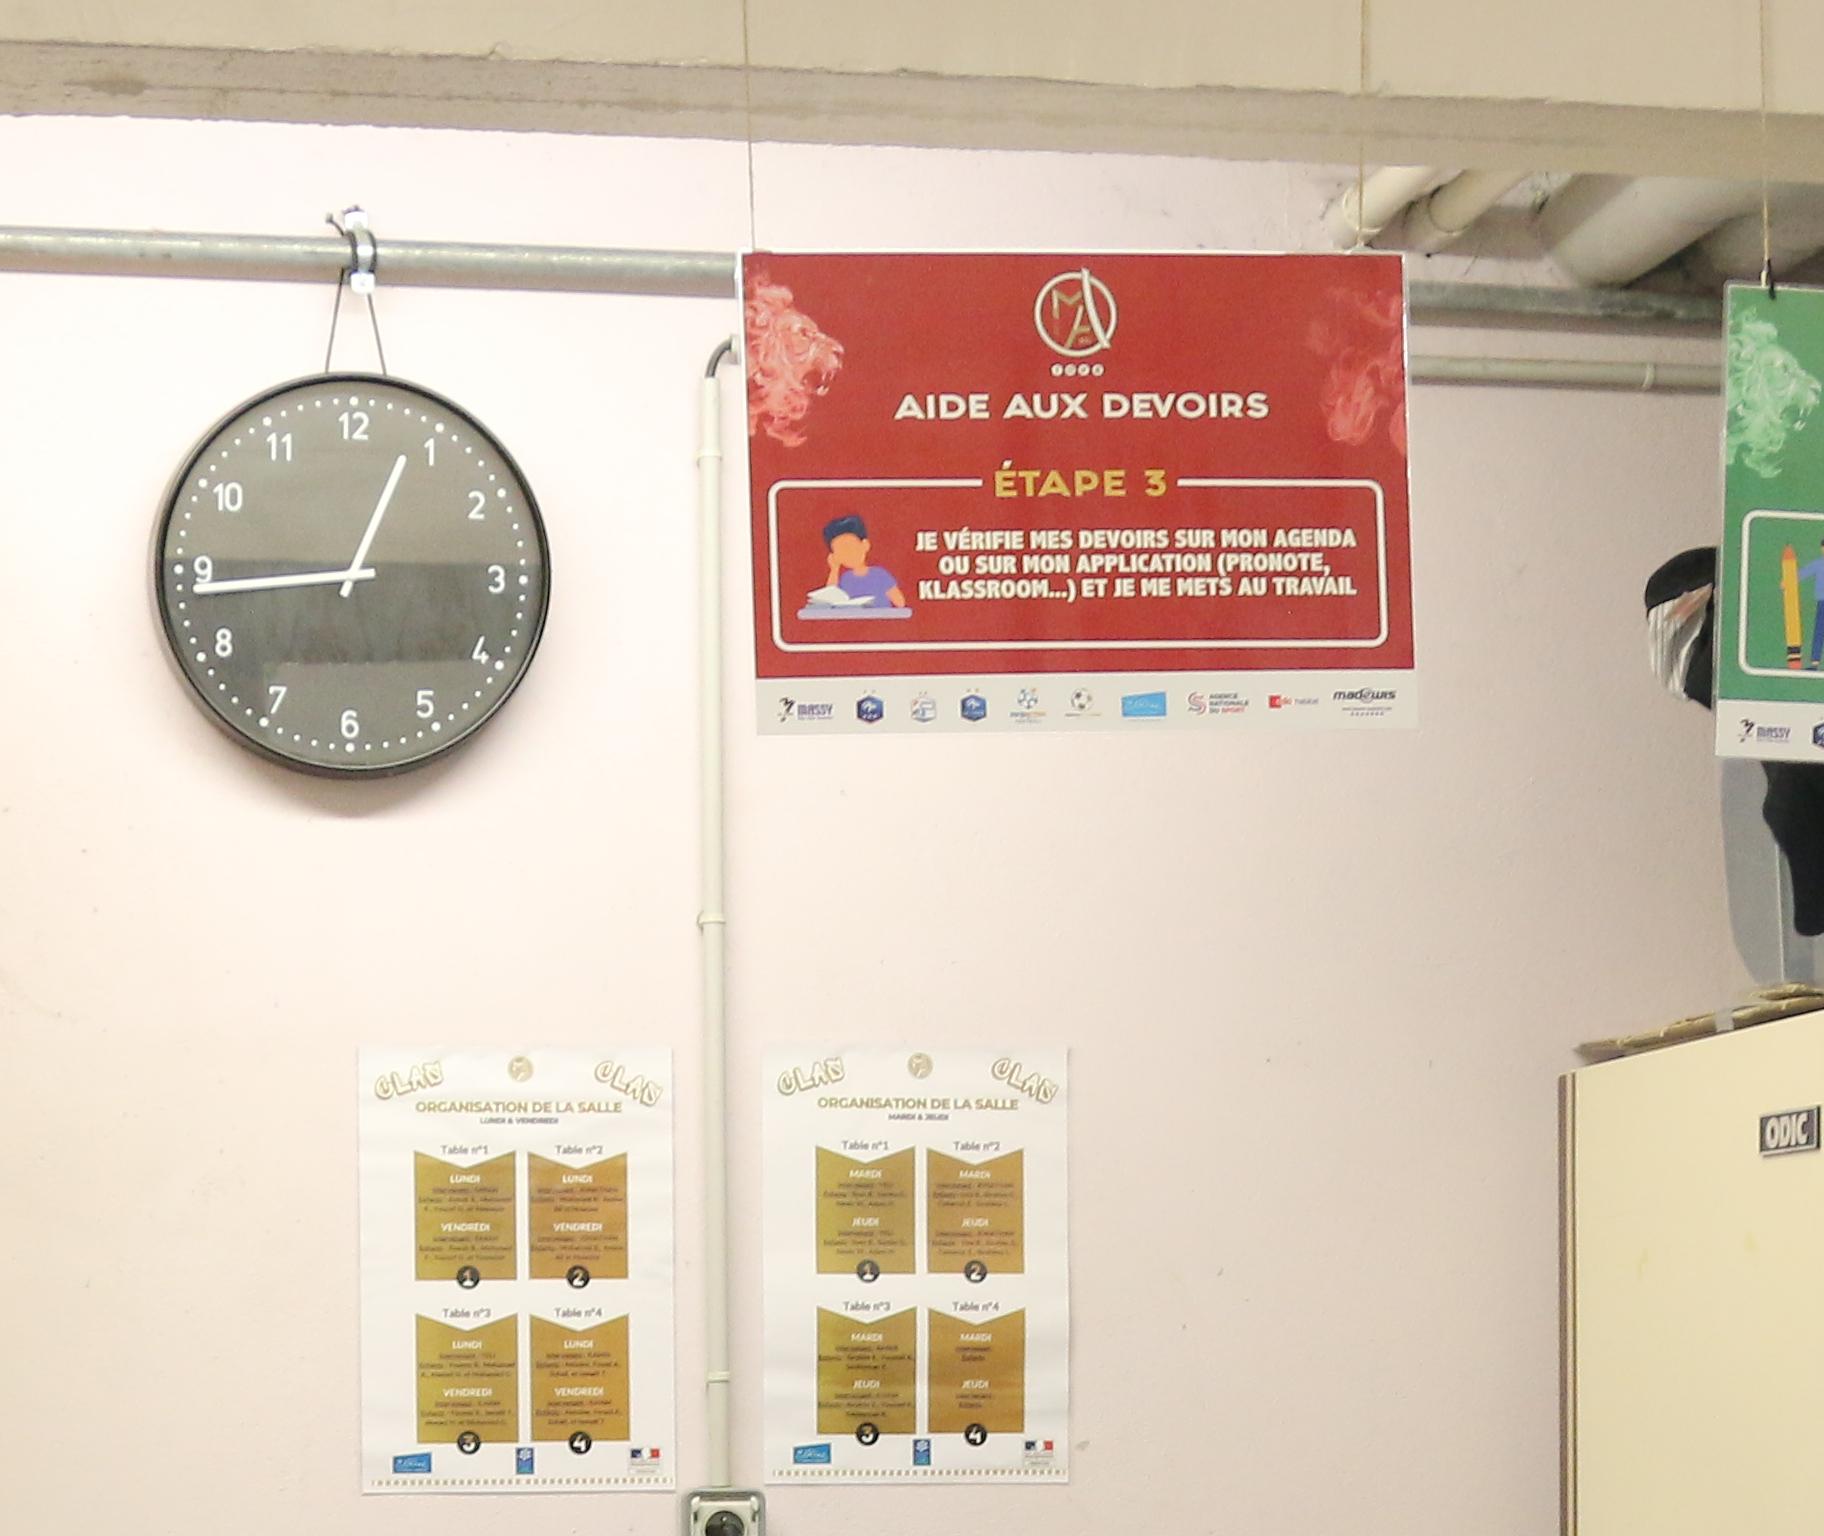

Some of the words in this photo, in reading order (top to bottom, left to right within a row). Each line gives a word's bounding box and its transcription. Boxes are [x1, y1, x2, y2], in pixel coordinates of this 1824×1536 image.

[895, 394, 989, 419] AIDE
[1004, 394, 1087, 418] AUX
[1103, 393, 1268, 418] DEVOIRS
[339, 412, 369, 440] 12
[267, 433, 291, 461] 11
[424, 438, 434, 466] 1
[995, 460, 1126, 497] ÉTAPE
[1145, 470, 1166, 496] 3
[213, 482, 242, 511] 10
[468, 491, 485, 519] 2
[916, 532, 937, 550] JE
[944, 527, 1024, 550] VÉRIFIE
[1030, 531, 1073, 549] MES
[1079, 530, 1169, 548] DEVOIRS
[1175, 529, 1215, 548] SUR
[1221, 529, 1267, 547] MON
[1274, 529, 1356, 547] AGENDA
[193, 556, 213, 583] 9
[939, 556, 969, 574] OU
[976, 555, 1016, 574] SUR
[1023, 555, 1070, 573] MON
[1076, 553, 1211, 573] APPLICATION
[1217, 552, 1331, 577] (PRONOTE,
[488, 565, 505, 593] 3
[919, 579, 1076, 602] KLASSROOM...)
[1082, 579, 1108, 597] ET
[1114, 578, 1135, 597] JE
[1141, 578, 1171, 596] ME
[1177, 575, 1232, 596] METS
[1238, 577, 1266, 595] AU
[1272, 573, 1357, 595] TRAVAIL
[215, 629, 232, 657] 8
[473, 636, 489, 664] 4
[269, 686, 287, 714] 7
[417, 690, 434, 718] 5
[341, 710, 359, 738] 6
[416, 1101, 528, 1113] ORGANISATION
[532, 1101, 552, 1113] DE
[555, 1102, 574, 1113] LA
[578, 1102, 622, 1113] SALLE
[818, 1097, 927, 1109] ORGANISATION
[931, 1098, 950, 1109] DE
[954, 1099, 972, 1109] LA
[975, 1099, 1018, 1110] SALLE
[1765, 1111, 1809, 1149] ODIC
[442, 1145, 468, 1154] Table
[556, 1145, 583, 1154] Table
[843, 1140, 869, 1150] Table
[954, 1141, 980, 1150] Table
[449, 1175, 480, 1183] LUNDI
[562, 1175, 592, 1183] LUNDI
[849, 1170, 881, 1178] MARDI
[960, 1171, 991, 1179] MARDI
[441, 1223, 490, 1231] VENDREDI
[554, 1222, 602, 1231] VENDREDI
[852, 1217, 879, 1226] JEUDI
[962, 1218, 988, 1227] JEUDI
[462, 1268, 474, 1286] 1
[573, 1268, 585, 1286] 2
[862, 1263, 874, 1281] 1
[971, 1263, 982, 1281] 2
[555, 1308, 582, 1317] Table
[844, 1301, 871, 1311] Table
[953, 1301, 979, 1311] Table
[444, 1309, 471, 1318] Table
[851, 1333, 882, 1341] MARDI
[452, 1341, 482, 1349] LUNDI
[564, 1340, 593, 1348] LUNDI
[853, 1380, 879, 1389] JEUDI
[962, 1380, 988, 1388] JEUDI
[443, 1388, 492, 1397] VENDREDI
[555, 1387, 603, 1396] VENDREDI
[969, 1425, 983, 1443] 4
[574, 1433, 587, 1452] 4
